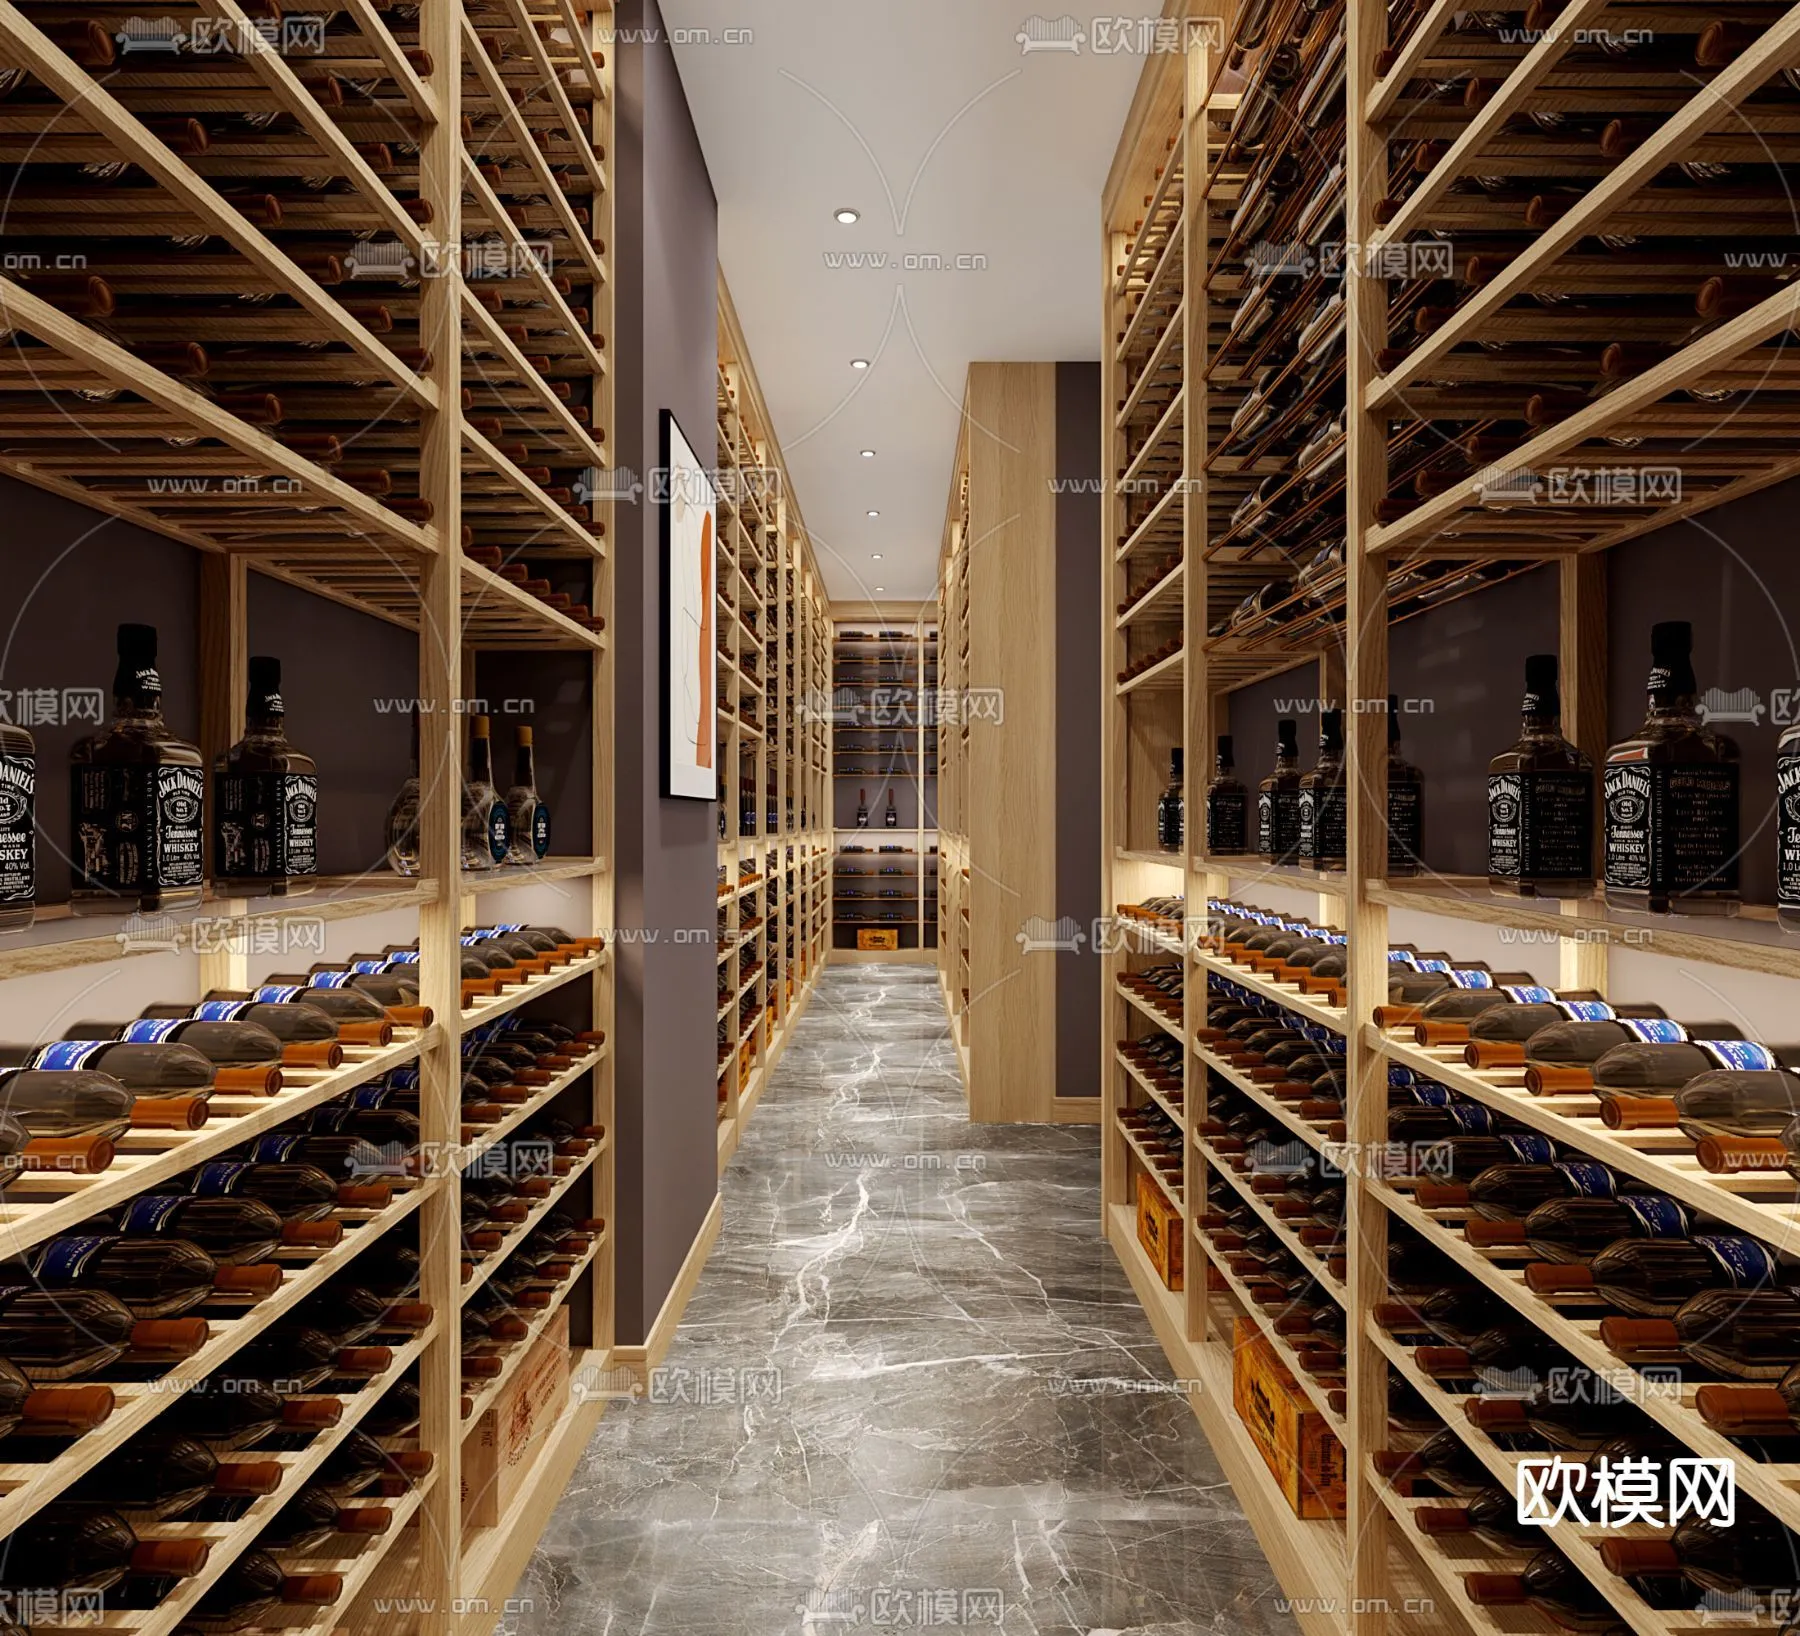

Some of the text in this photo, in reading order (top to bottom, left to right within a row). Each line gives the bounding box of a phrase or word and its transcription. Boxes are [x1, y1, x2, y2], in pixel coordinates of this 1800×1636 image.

[158, 775, 177, 798] JACK
[177, 771, 204, 799] DANIEL'S
[1604, 771, 1652, 799] JACK DANIEL'S
[165, 825, 198, 839] Tennessee
[1610, 825, 1644, 839] Tennessee
[163, 843, 199, 853] WHISKEY
[1608, 843, 1646, 854] WHISKEY
[4, 862, 18, 871] 40%
